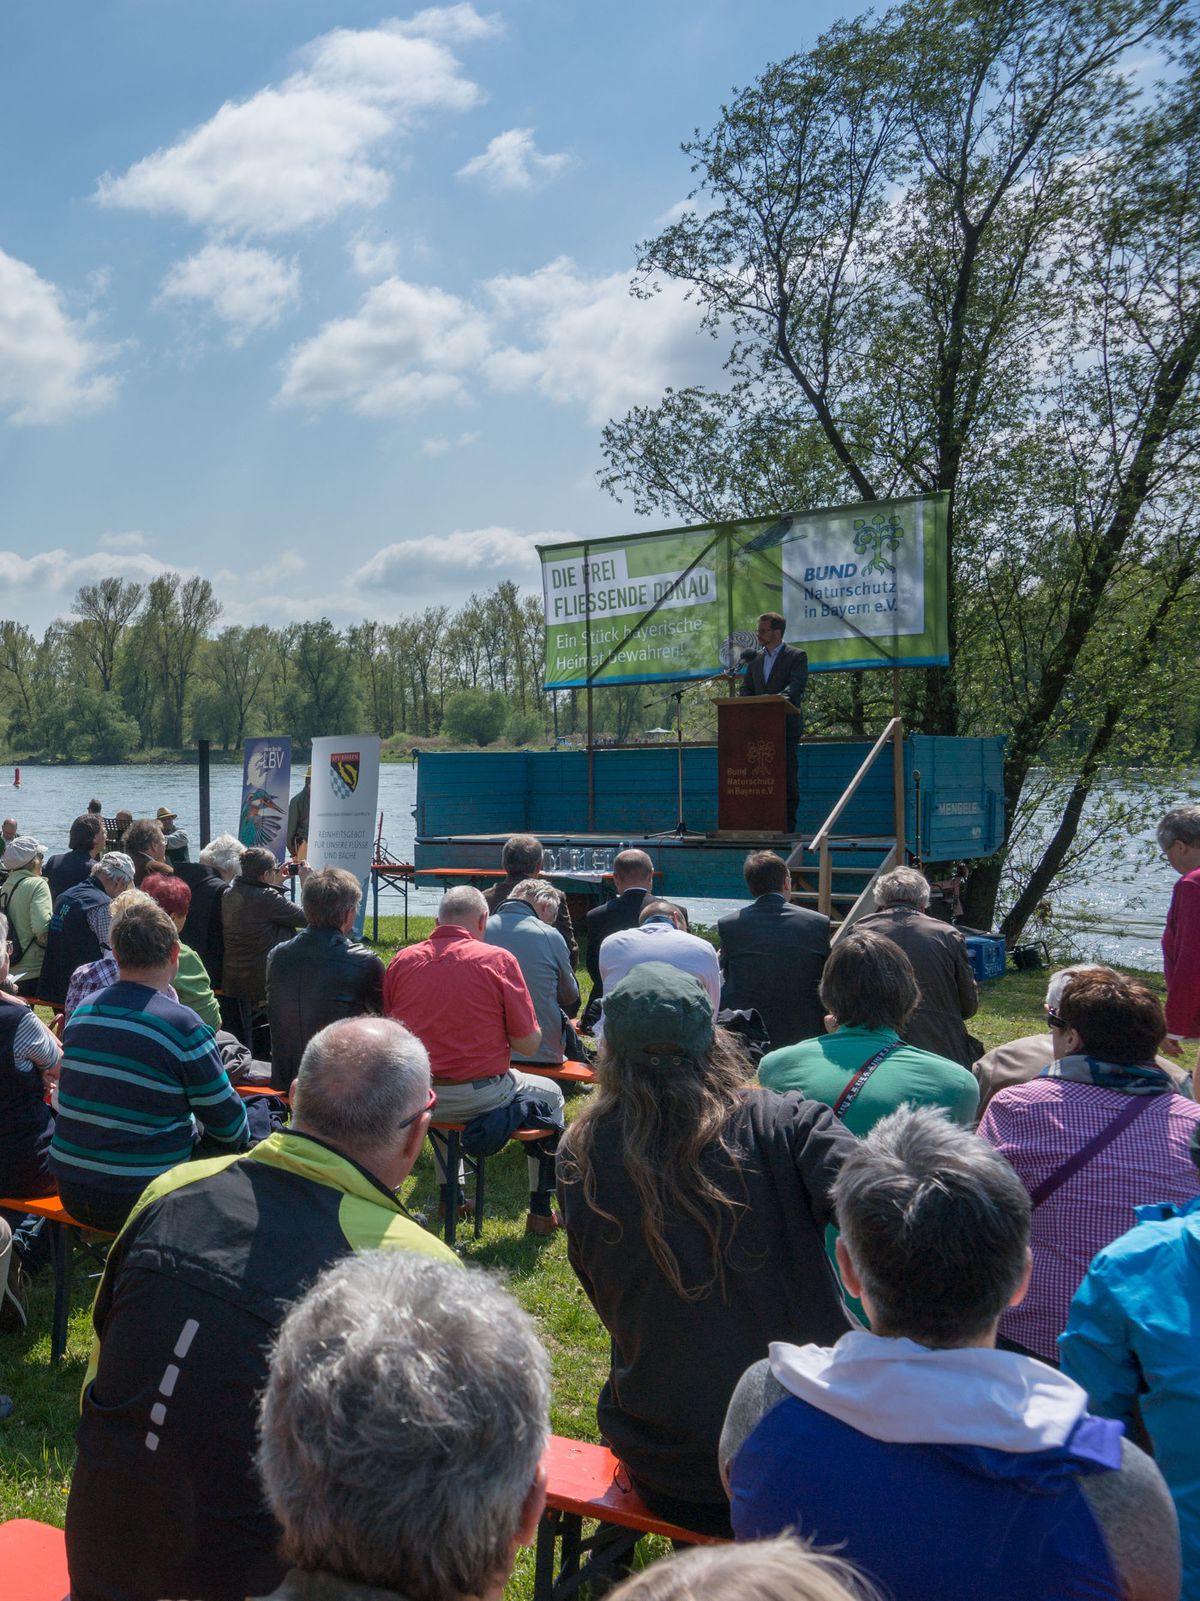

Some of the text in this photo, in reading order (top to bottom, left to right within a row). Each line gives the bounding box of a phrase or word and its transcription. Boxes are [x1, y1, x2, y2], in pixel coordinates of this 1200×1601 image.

[552, 559, 616, 589] DIE FREI
[804, 563, 857, 582] BUND
[554, 574, 709, 618] FLIESSENDE DONAU
[804, 581, 897, 600] Naturschutz
[804, 598, 897, 619] in Bayern e.V.
[556, 634, 577, 649] Ein
[581, 628, 619, 646] Stück
[556, 652, 604, 671] Heimat
[263, 751, 285, 769] LBV
[727, 777, 776, 786] Naturschutz
